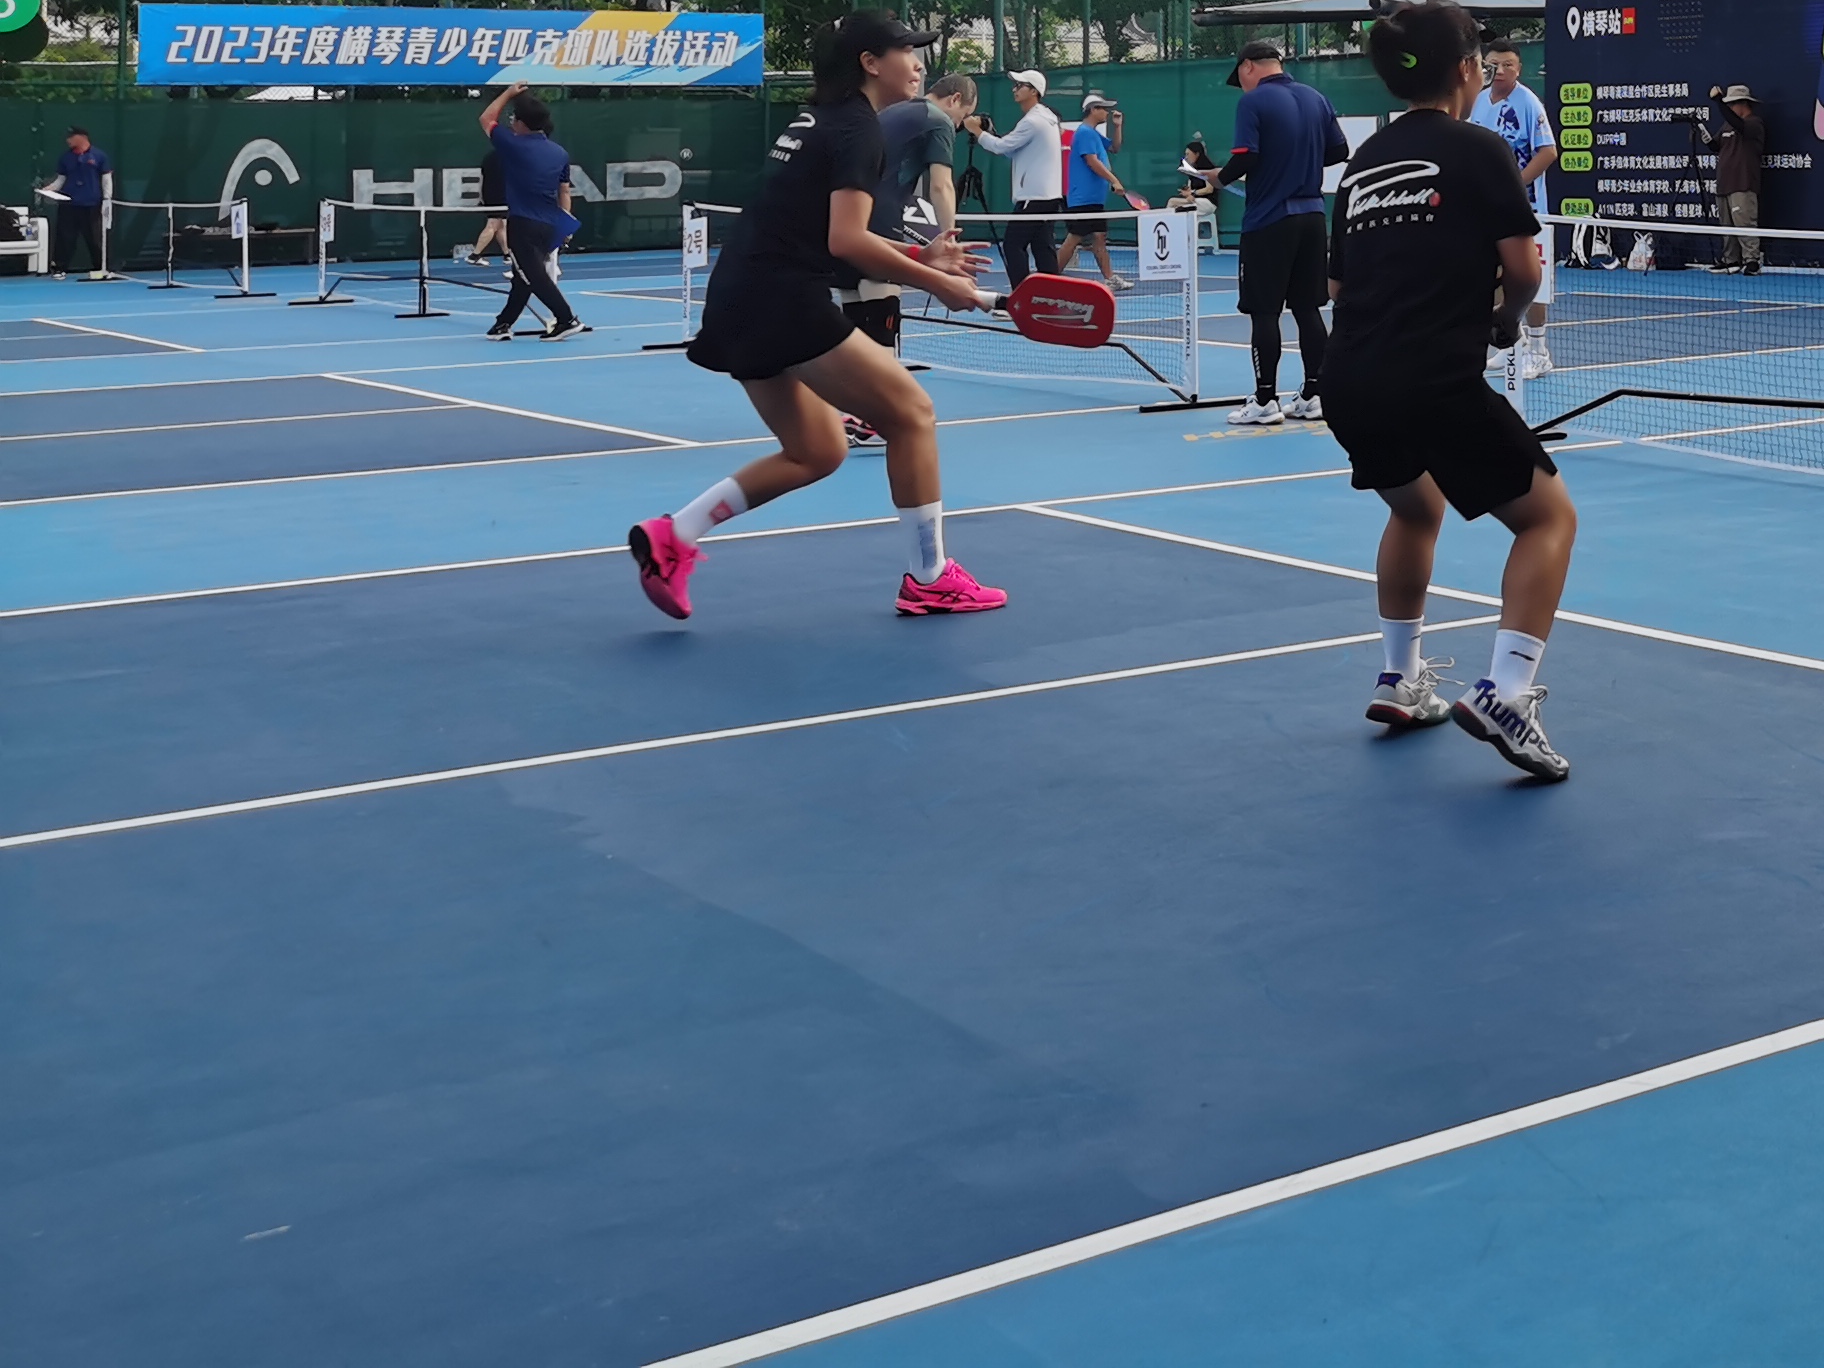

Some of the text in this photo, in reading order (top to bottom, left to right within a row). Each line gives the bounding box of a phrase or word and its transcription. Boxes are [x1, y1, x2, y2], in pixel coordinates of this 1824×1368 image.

[1582, 7, 1621, 37] 横琴站
[166, 24, 740, 68] 2023年度横琴青少年匹克球队选拔活动
[352, 161, 683, 209] HED
[1507, 345, 1516, 391] PICKL
